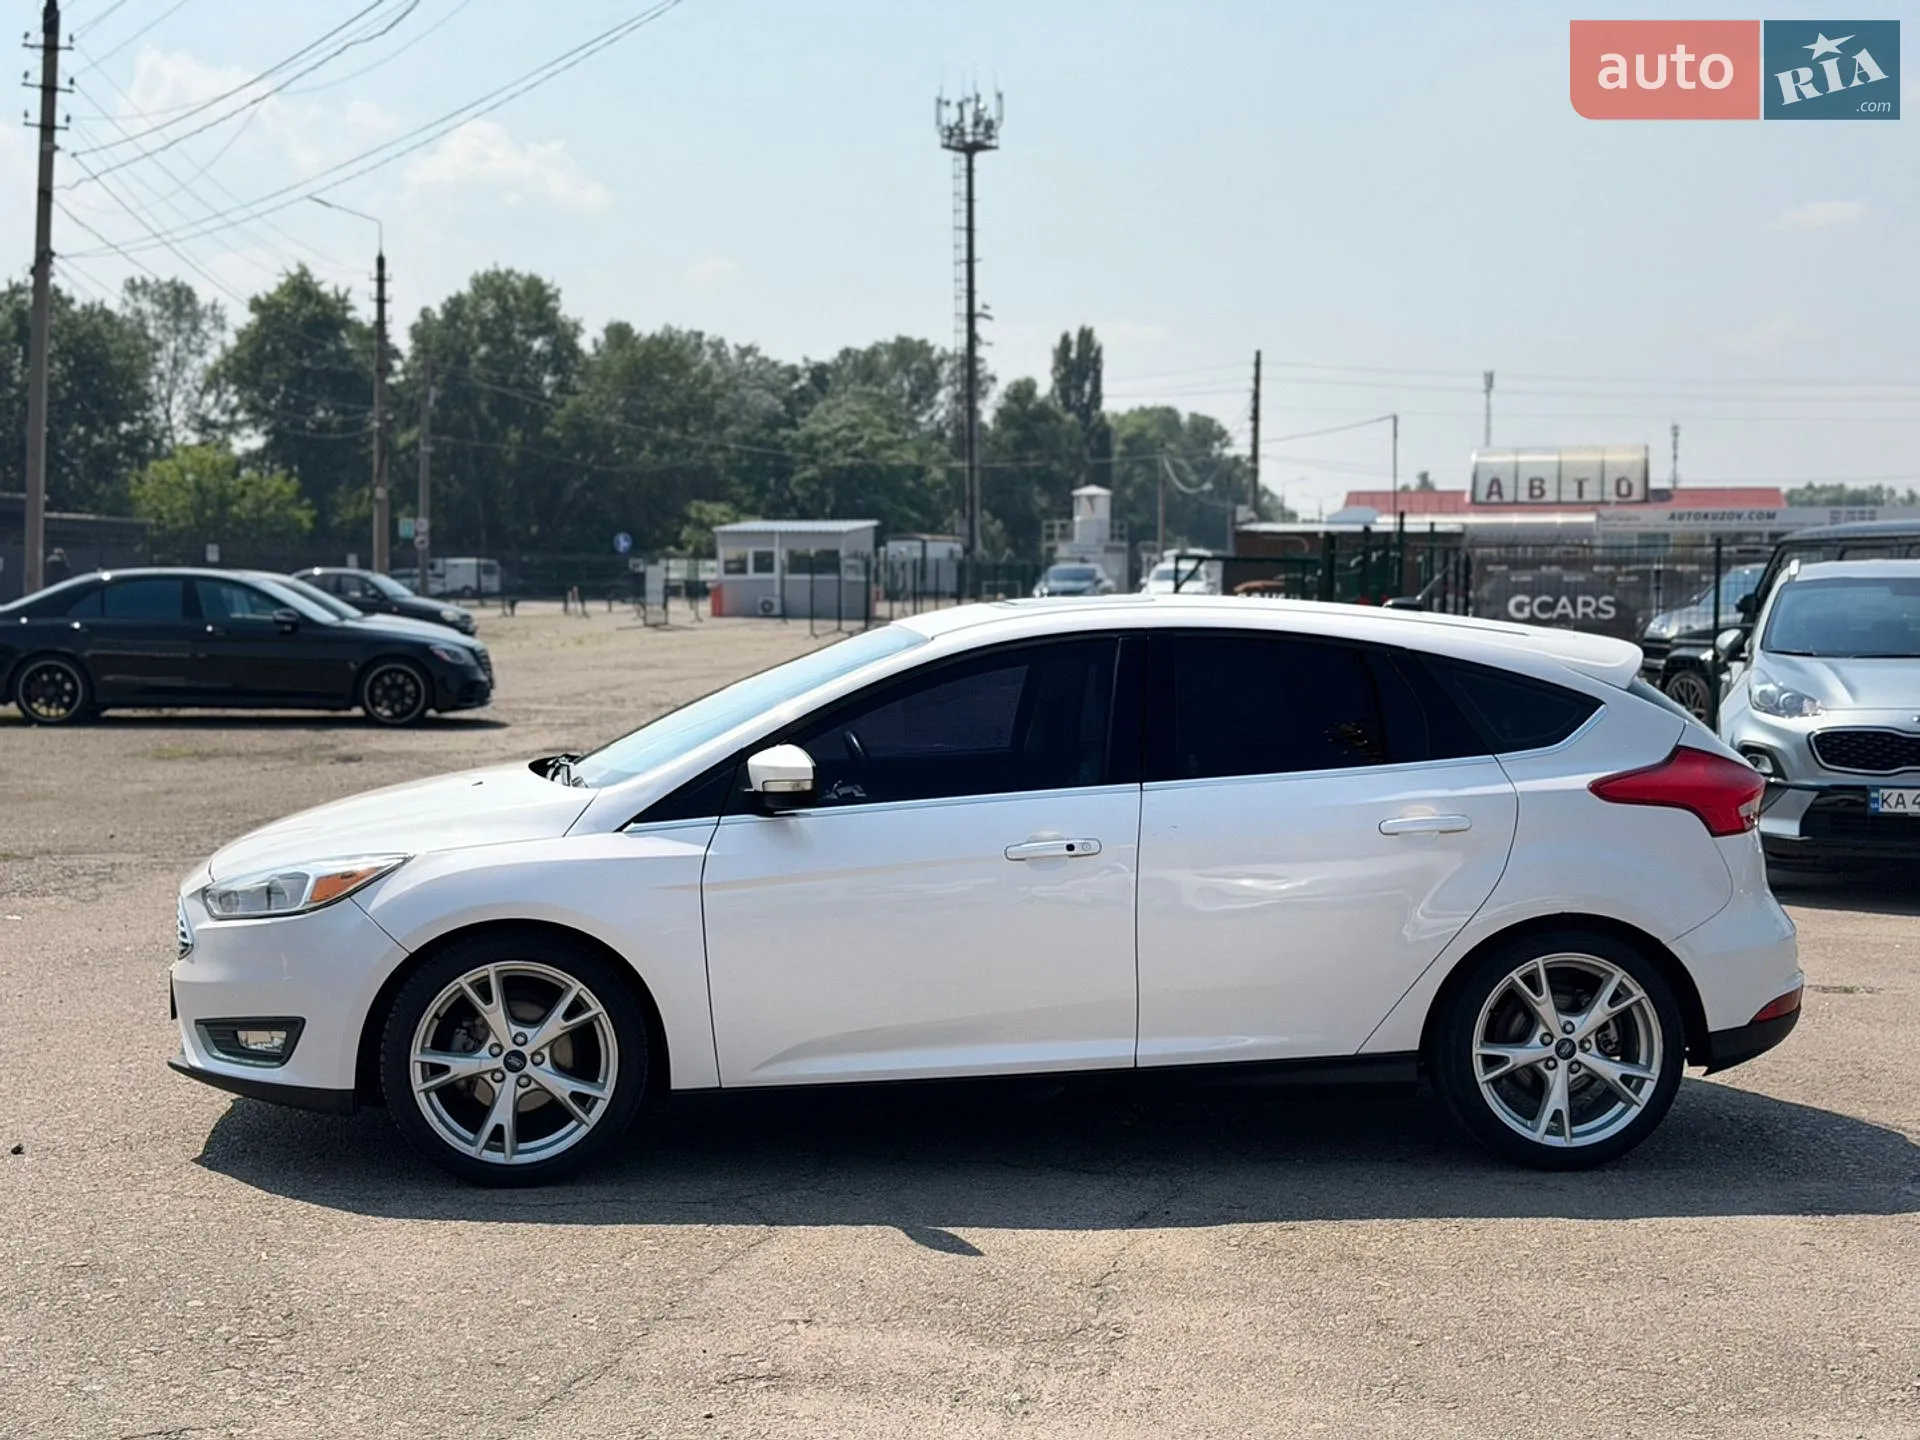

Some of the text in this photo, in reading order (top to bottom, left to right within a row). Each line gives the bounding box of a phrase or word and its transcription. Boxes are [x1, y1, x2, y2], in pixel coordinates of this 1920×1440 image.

[1668, 510, 1777, 521] AUTOKUZOV.COM
[1507, 595, 1617, 620] GCARS
[1881, 792, 1907, 809] KA
